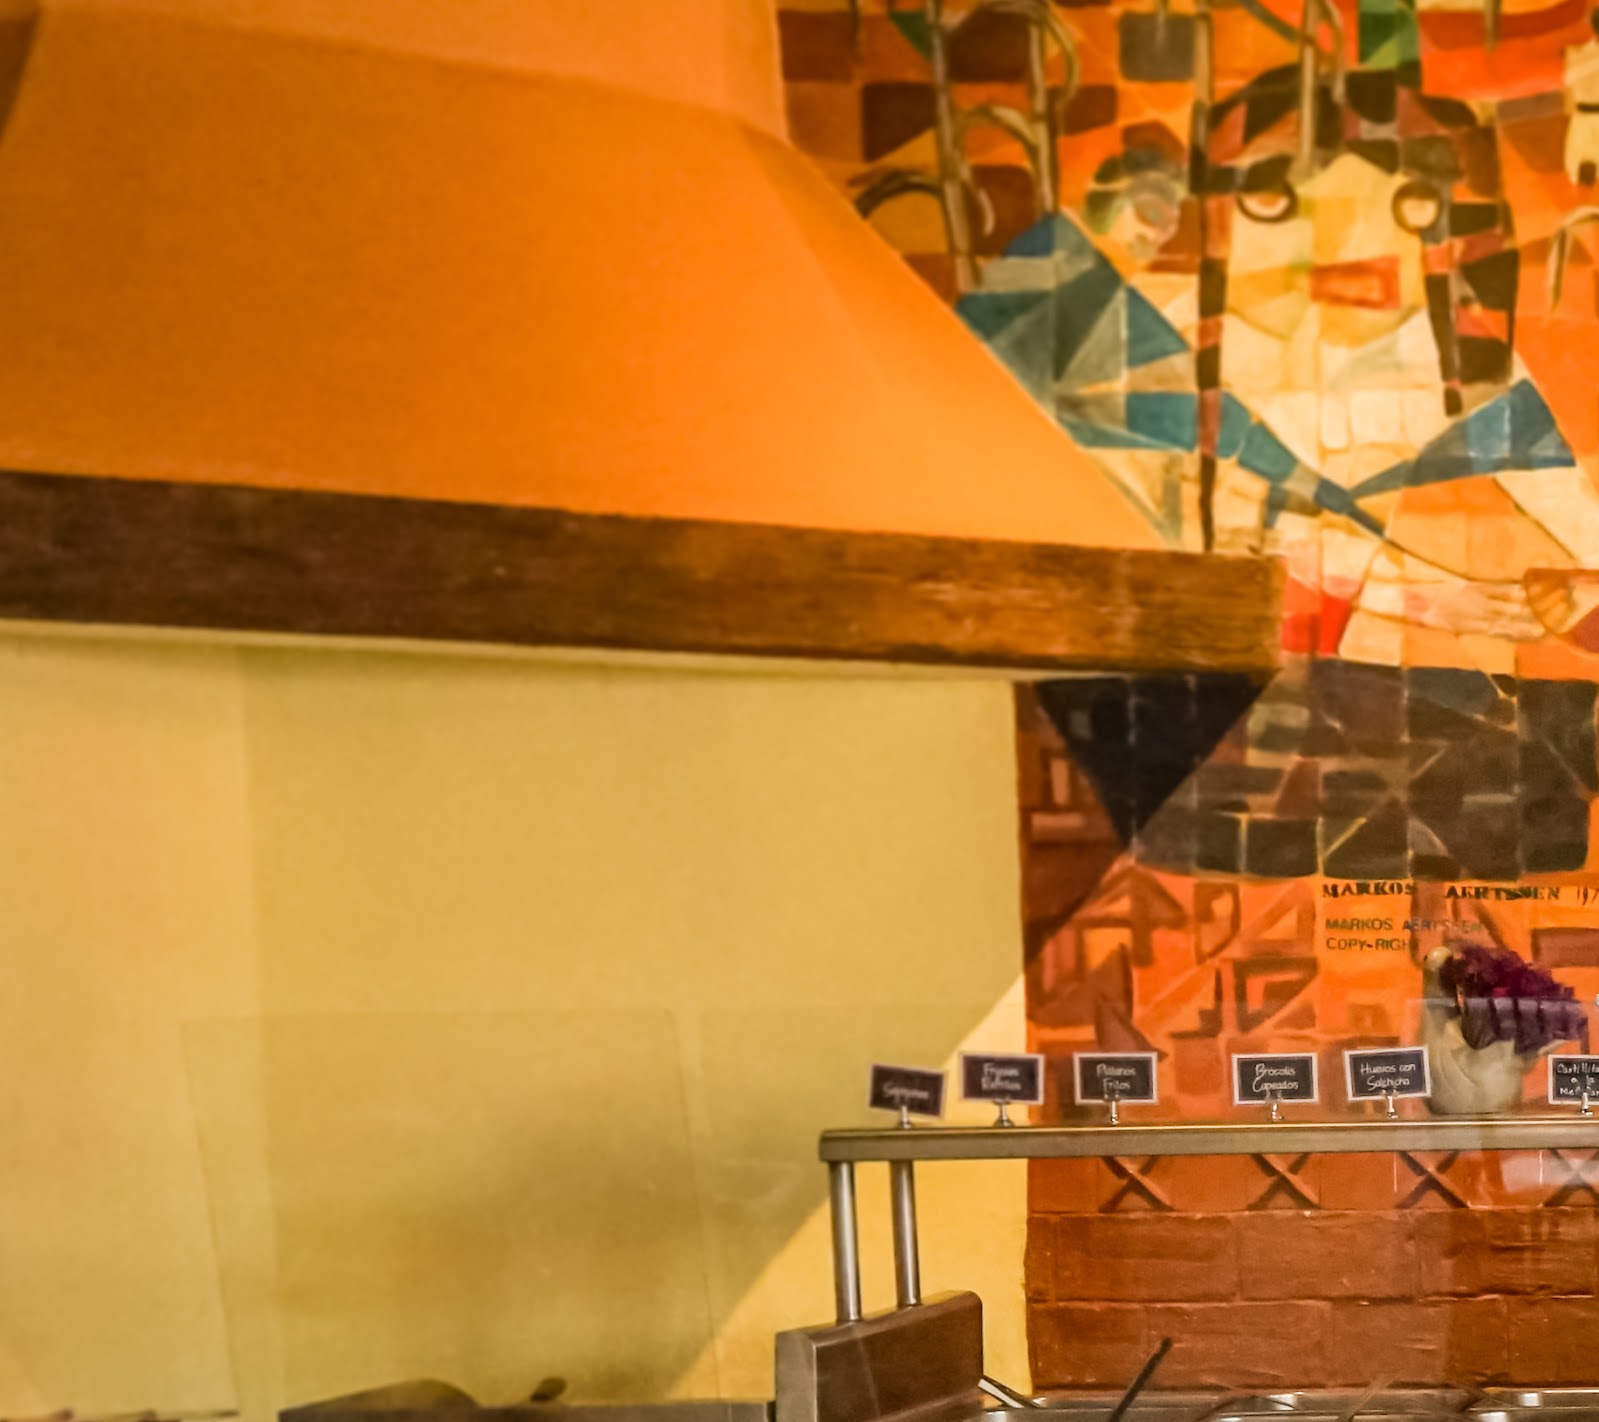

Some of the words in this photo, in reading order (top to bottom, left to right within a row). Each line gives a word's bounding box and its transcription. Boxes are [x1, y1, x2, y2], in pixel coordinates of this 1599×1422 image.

[1322, 881, 1418, 898] MARKOS
[1325, 918, 1393, 931] MARKOS
[1326, 937, 1419, 951] COPY-RIGH
